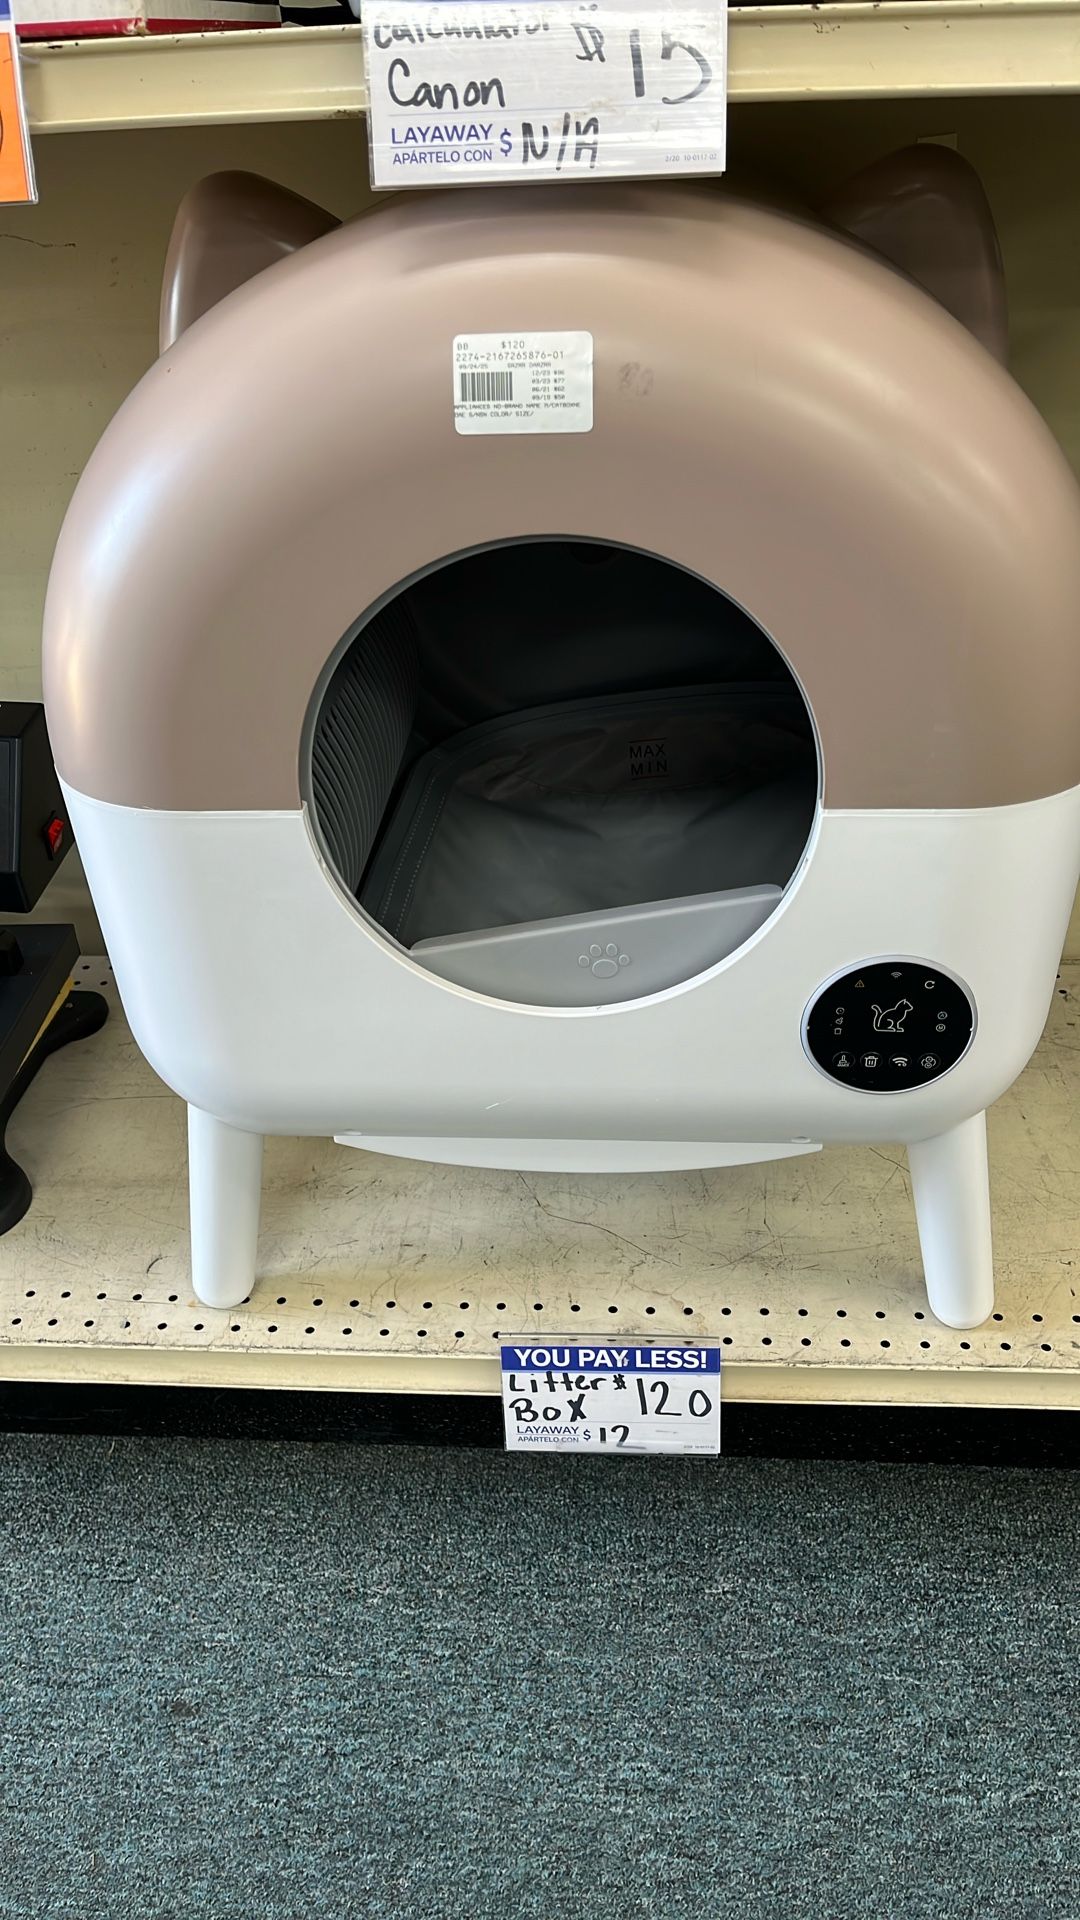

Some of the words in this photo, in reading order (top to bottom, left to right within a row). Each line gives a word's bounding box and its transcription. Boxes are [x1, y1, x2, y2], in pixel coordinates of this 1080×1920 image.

[388, 58, 506, 109] Canon
[391, 123, 493, 144] LAYAWAY
[392, 150, 460, 165] APÁRTELO
[463, 149, 493, 162] CON
[501, 340, 525, 350] $120
[629, 743, 666, 759] MAX
[631, 760, 668, 775] MIN
[514, 1349, 570, 1367] YOU
[578, 1349, 629, 1367] PAY
[635, 1350, 707, 1368] LESS!
[509, 1371, 607, 1393] Litter
[516, 1425, 579, 1435] LAYAWAY
[517, 1435, 560, 1443] APÁRTELO
